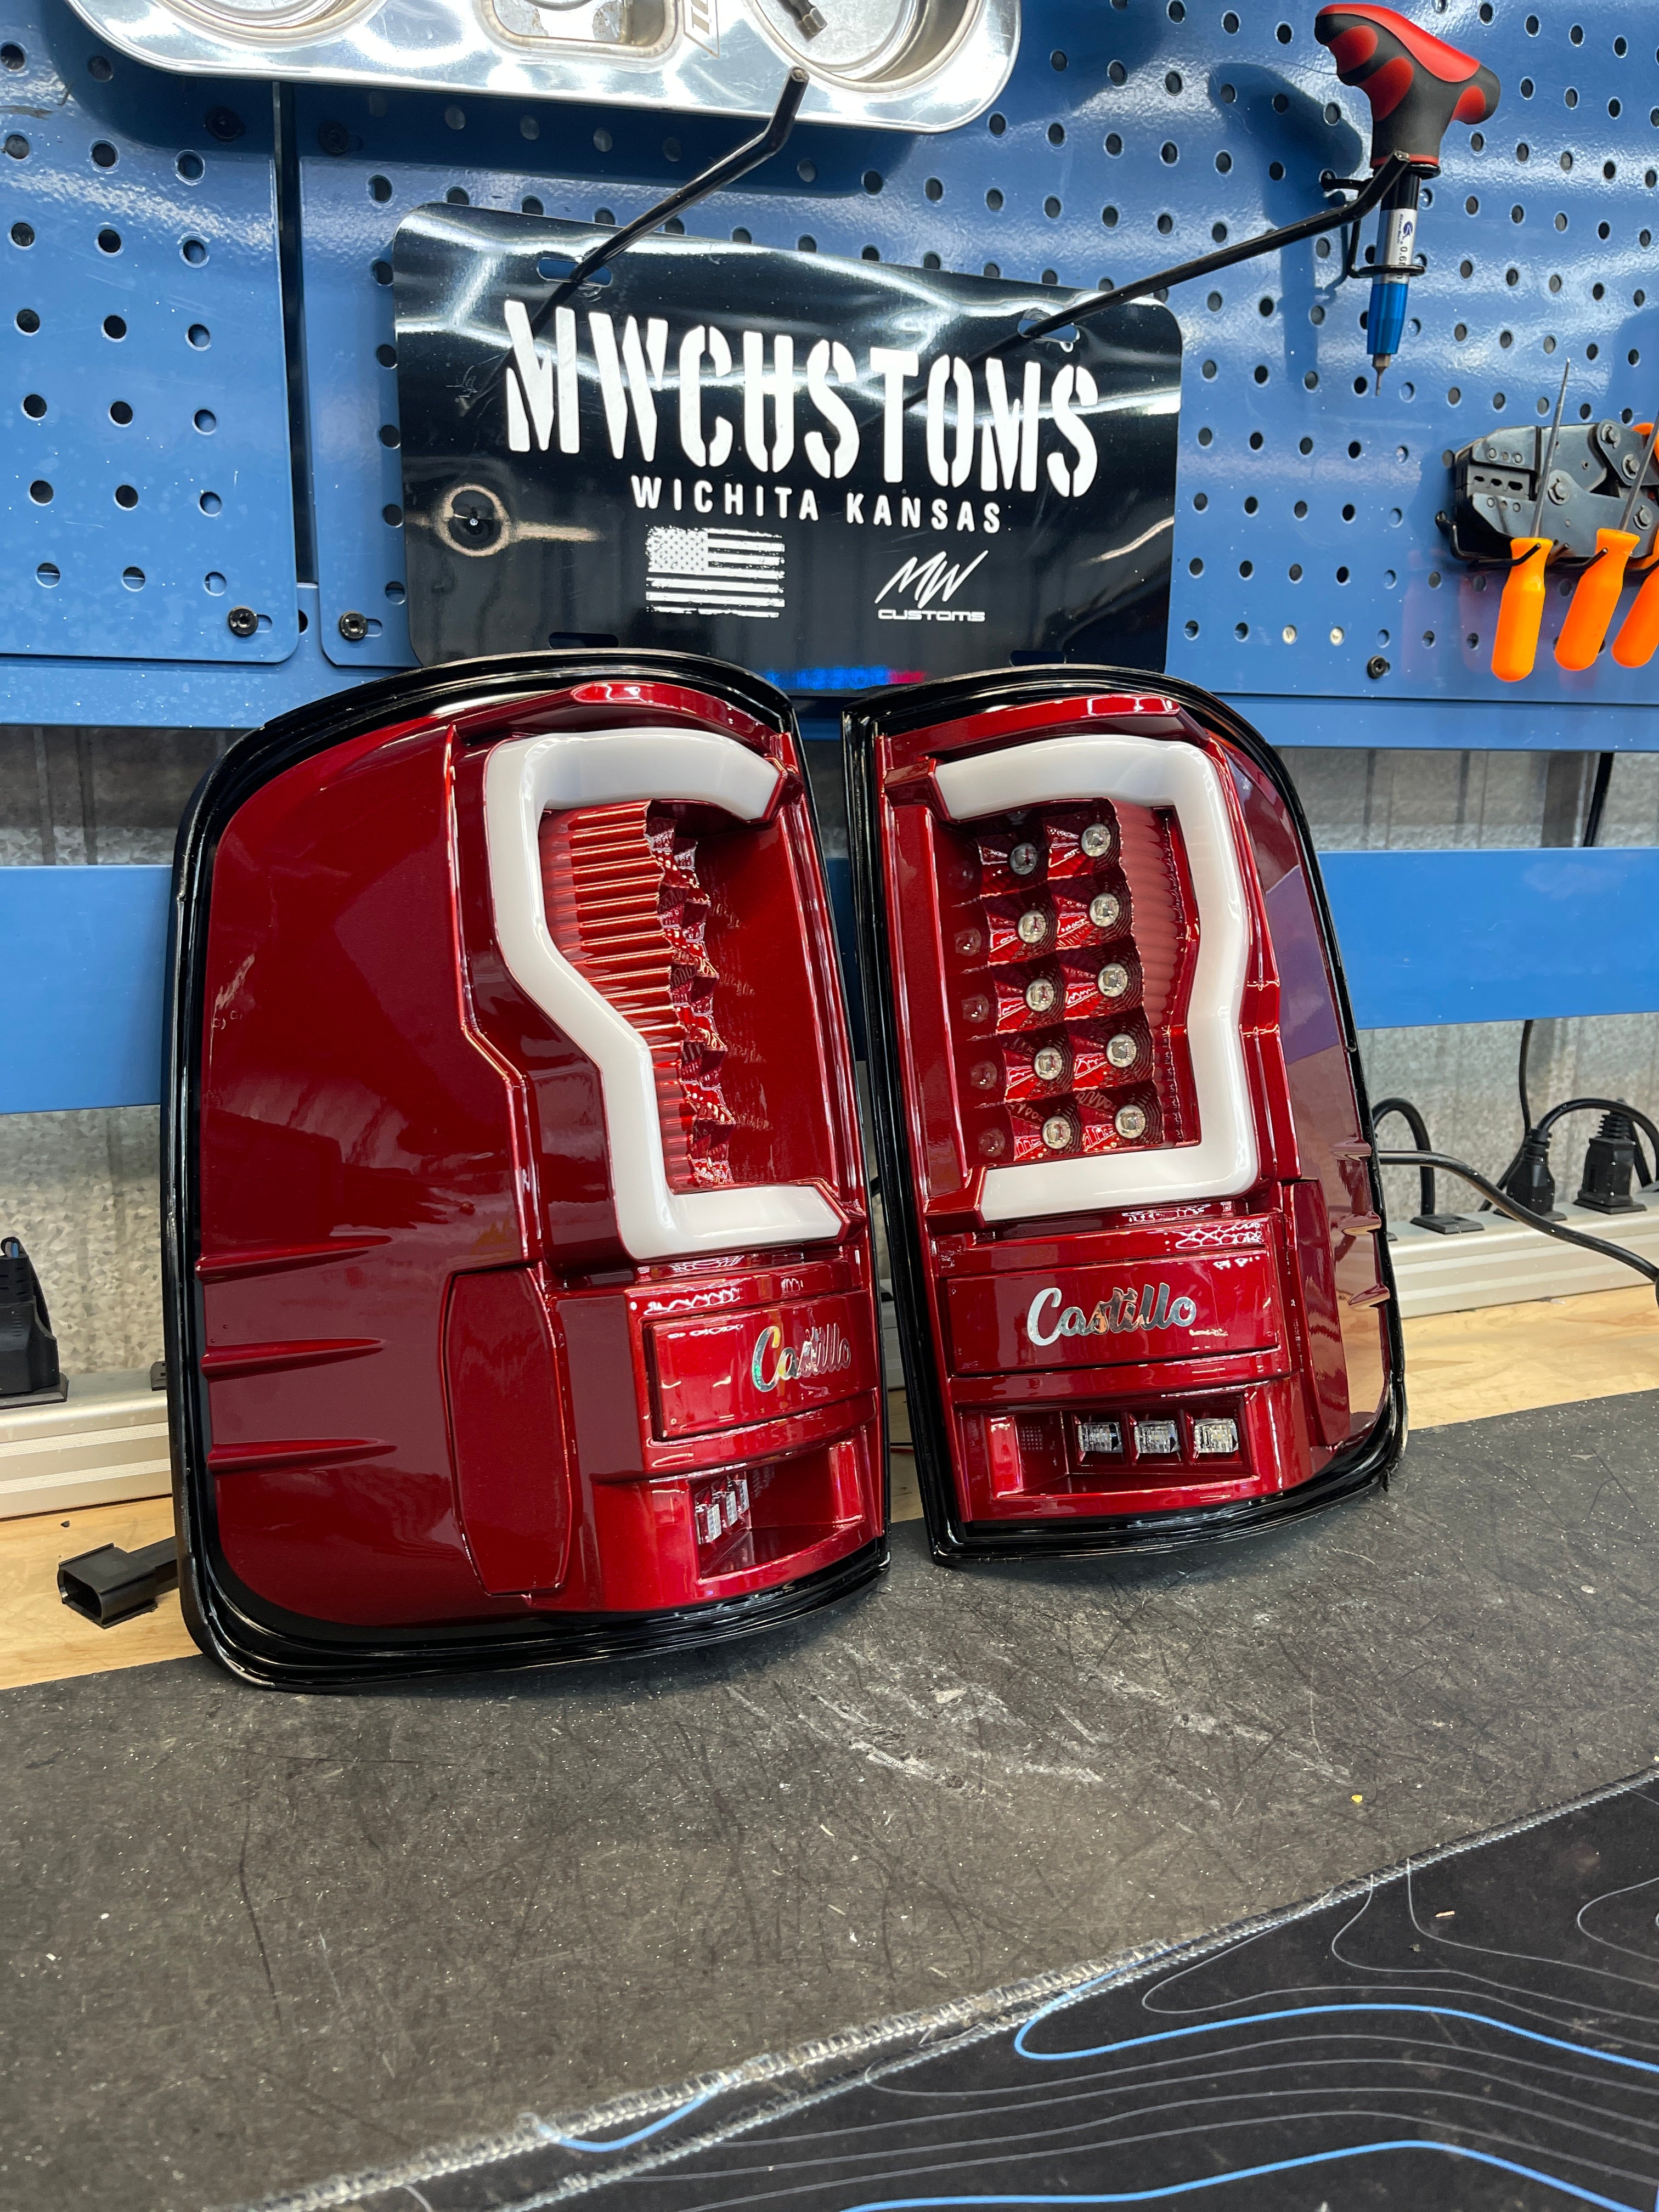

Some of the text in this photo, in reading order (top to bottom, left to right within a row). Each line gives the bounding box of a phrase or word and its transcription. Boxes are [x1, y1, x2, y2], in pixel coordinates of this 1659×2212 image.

[504, 300, 1099, 498] MWCUSTOMS
[631, 475, 1000, 533] WICHITA KANSAS
[874, 550, 989, 609] MW
[878, 608, 986, 622] CUSTOMS
[1026, 1282, 1197, 1346] Castillo
[752, 1323, 851, 1393] Castillo
